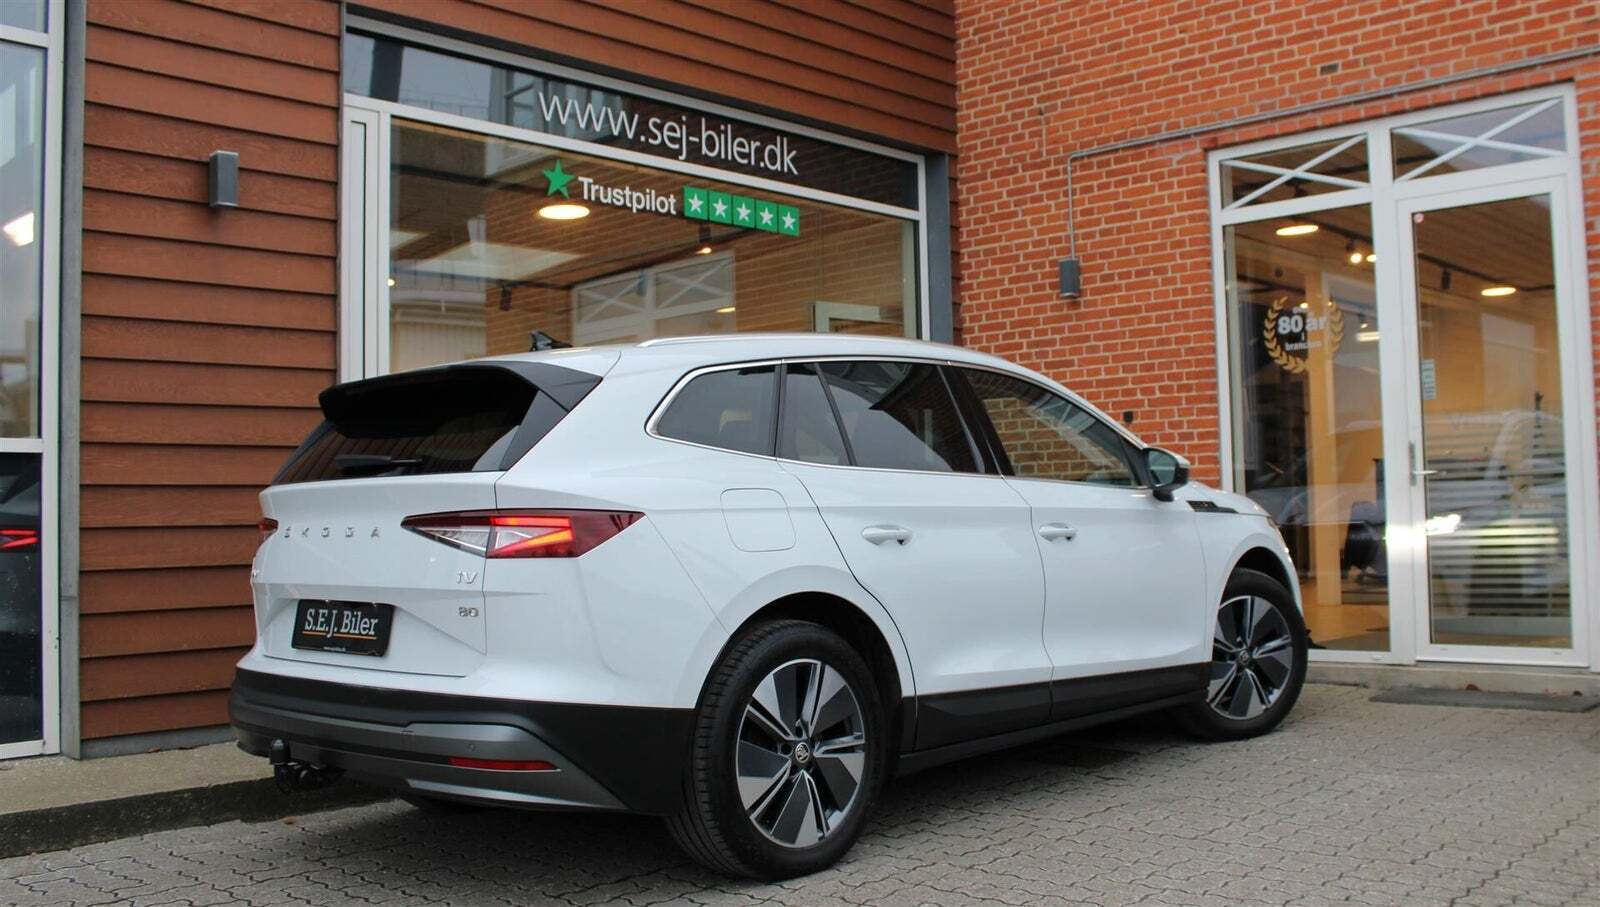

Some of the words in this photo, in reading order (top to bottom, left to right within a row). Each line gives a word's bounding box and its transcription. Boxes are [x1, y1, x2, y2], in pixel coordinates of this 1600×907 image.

[538, 91, 798, 176] www.sej-biler.dk
[577, 176, 676, 215] Trustpilot
[1278, 315, 1303, 334] 80
[304, 609, 338, 638] S.E.J.
[340, 610, 378, 635] Biler
